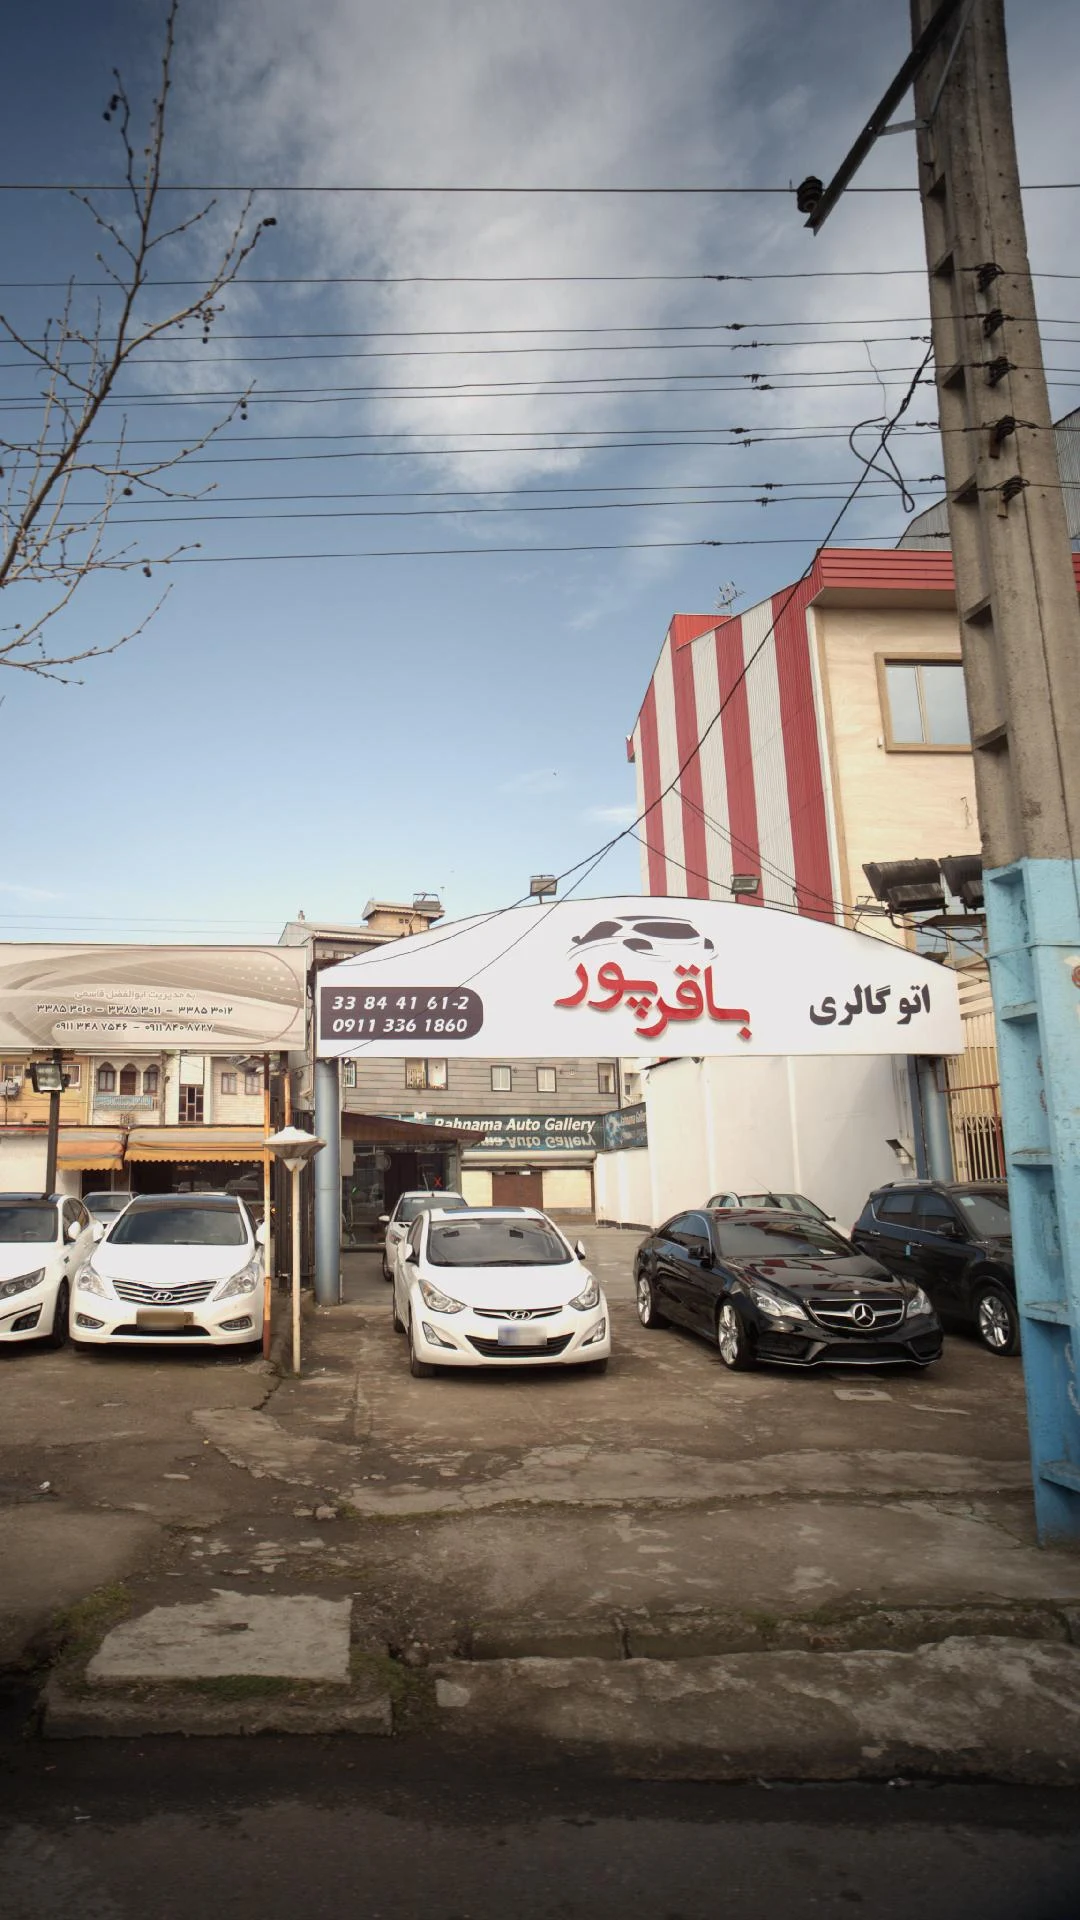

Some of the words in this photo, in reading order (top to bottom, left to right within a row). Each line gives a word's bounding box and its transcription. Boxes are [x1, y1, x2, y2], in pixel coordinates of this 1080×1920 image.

[75, 990, 104, 1000] قاسمی
[106, 990, 146, 1000] ابوالفضل
[149, 991, 184, 1001] مدیریت
[332, 996, 356, 1010] 33
[363, 996, 387, 1010] 84
[395, 996, 417, 1010] 41
[427, 996, 470, 1010] 61-2
[810, 983, 891, 1026] گالری
[897, 983, 931, 1025] اتو
[332, 1018, 376, 1033] 0911
[383, 1018, 417, 1033] 336
[425, 1018, 468, 1033] 1860
[434, 1117, 503, 1132] Rahnama
[505, 1118, 541, 1131] Auto
[544, 1117, 597, 1134] Gallery
